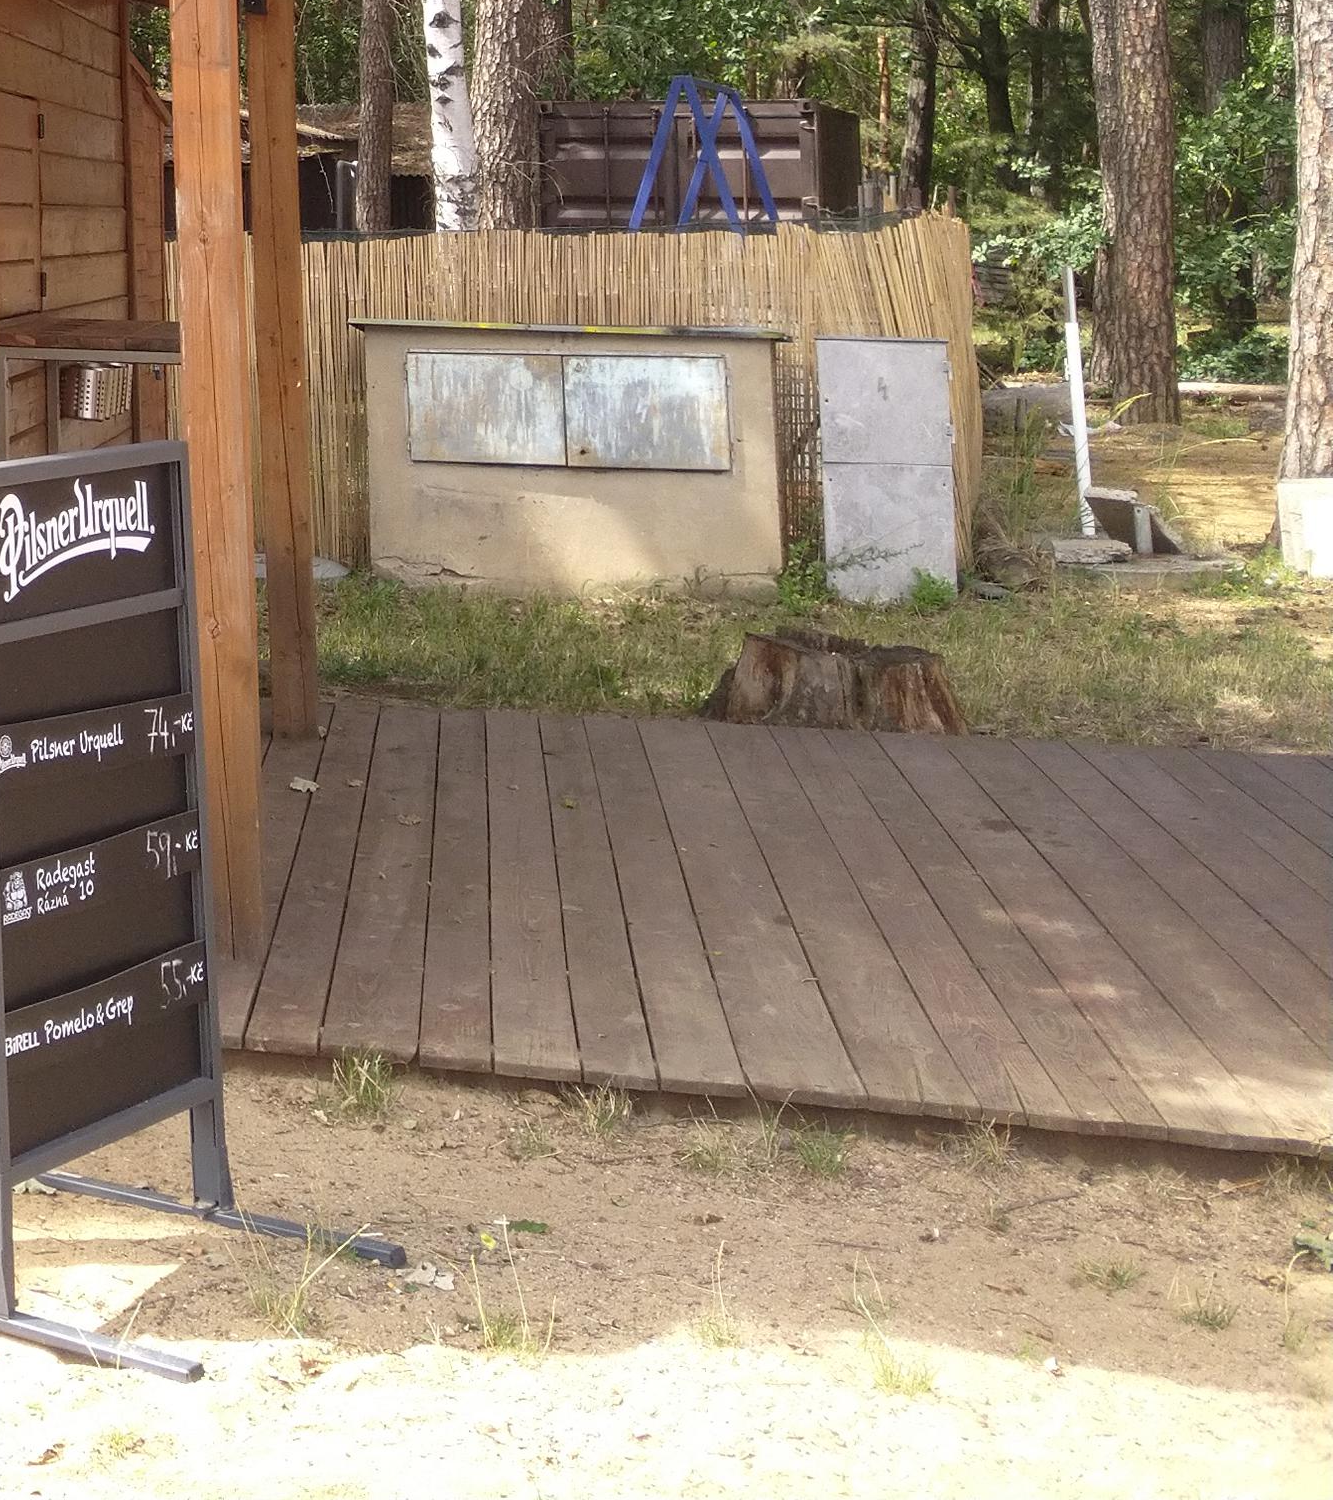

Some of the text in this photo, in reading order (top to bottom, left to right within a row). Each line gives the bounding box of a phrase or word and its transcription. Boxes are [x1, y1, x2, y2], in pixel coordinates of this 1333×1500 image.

[0, 493, 78, 602] Pilsner
[30, 737, 76, 763] Pilsner
[80, 723, 124, 762] Urquell
[37, 852, 95, 890] Radegast
[186, 830, 198, 852] Kč
[37, 880, 94, 914] Rázná 10
